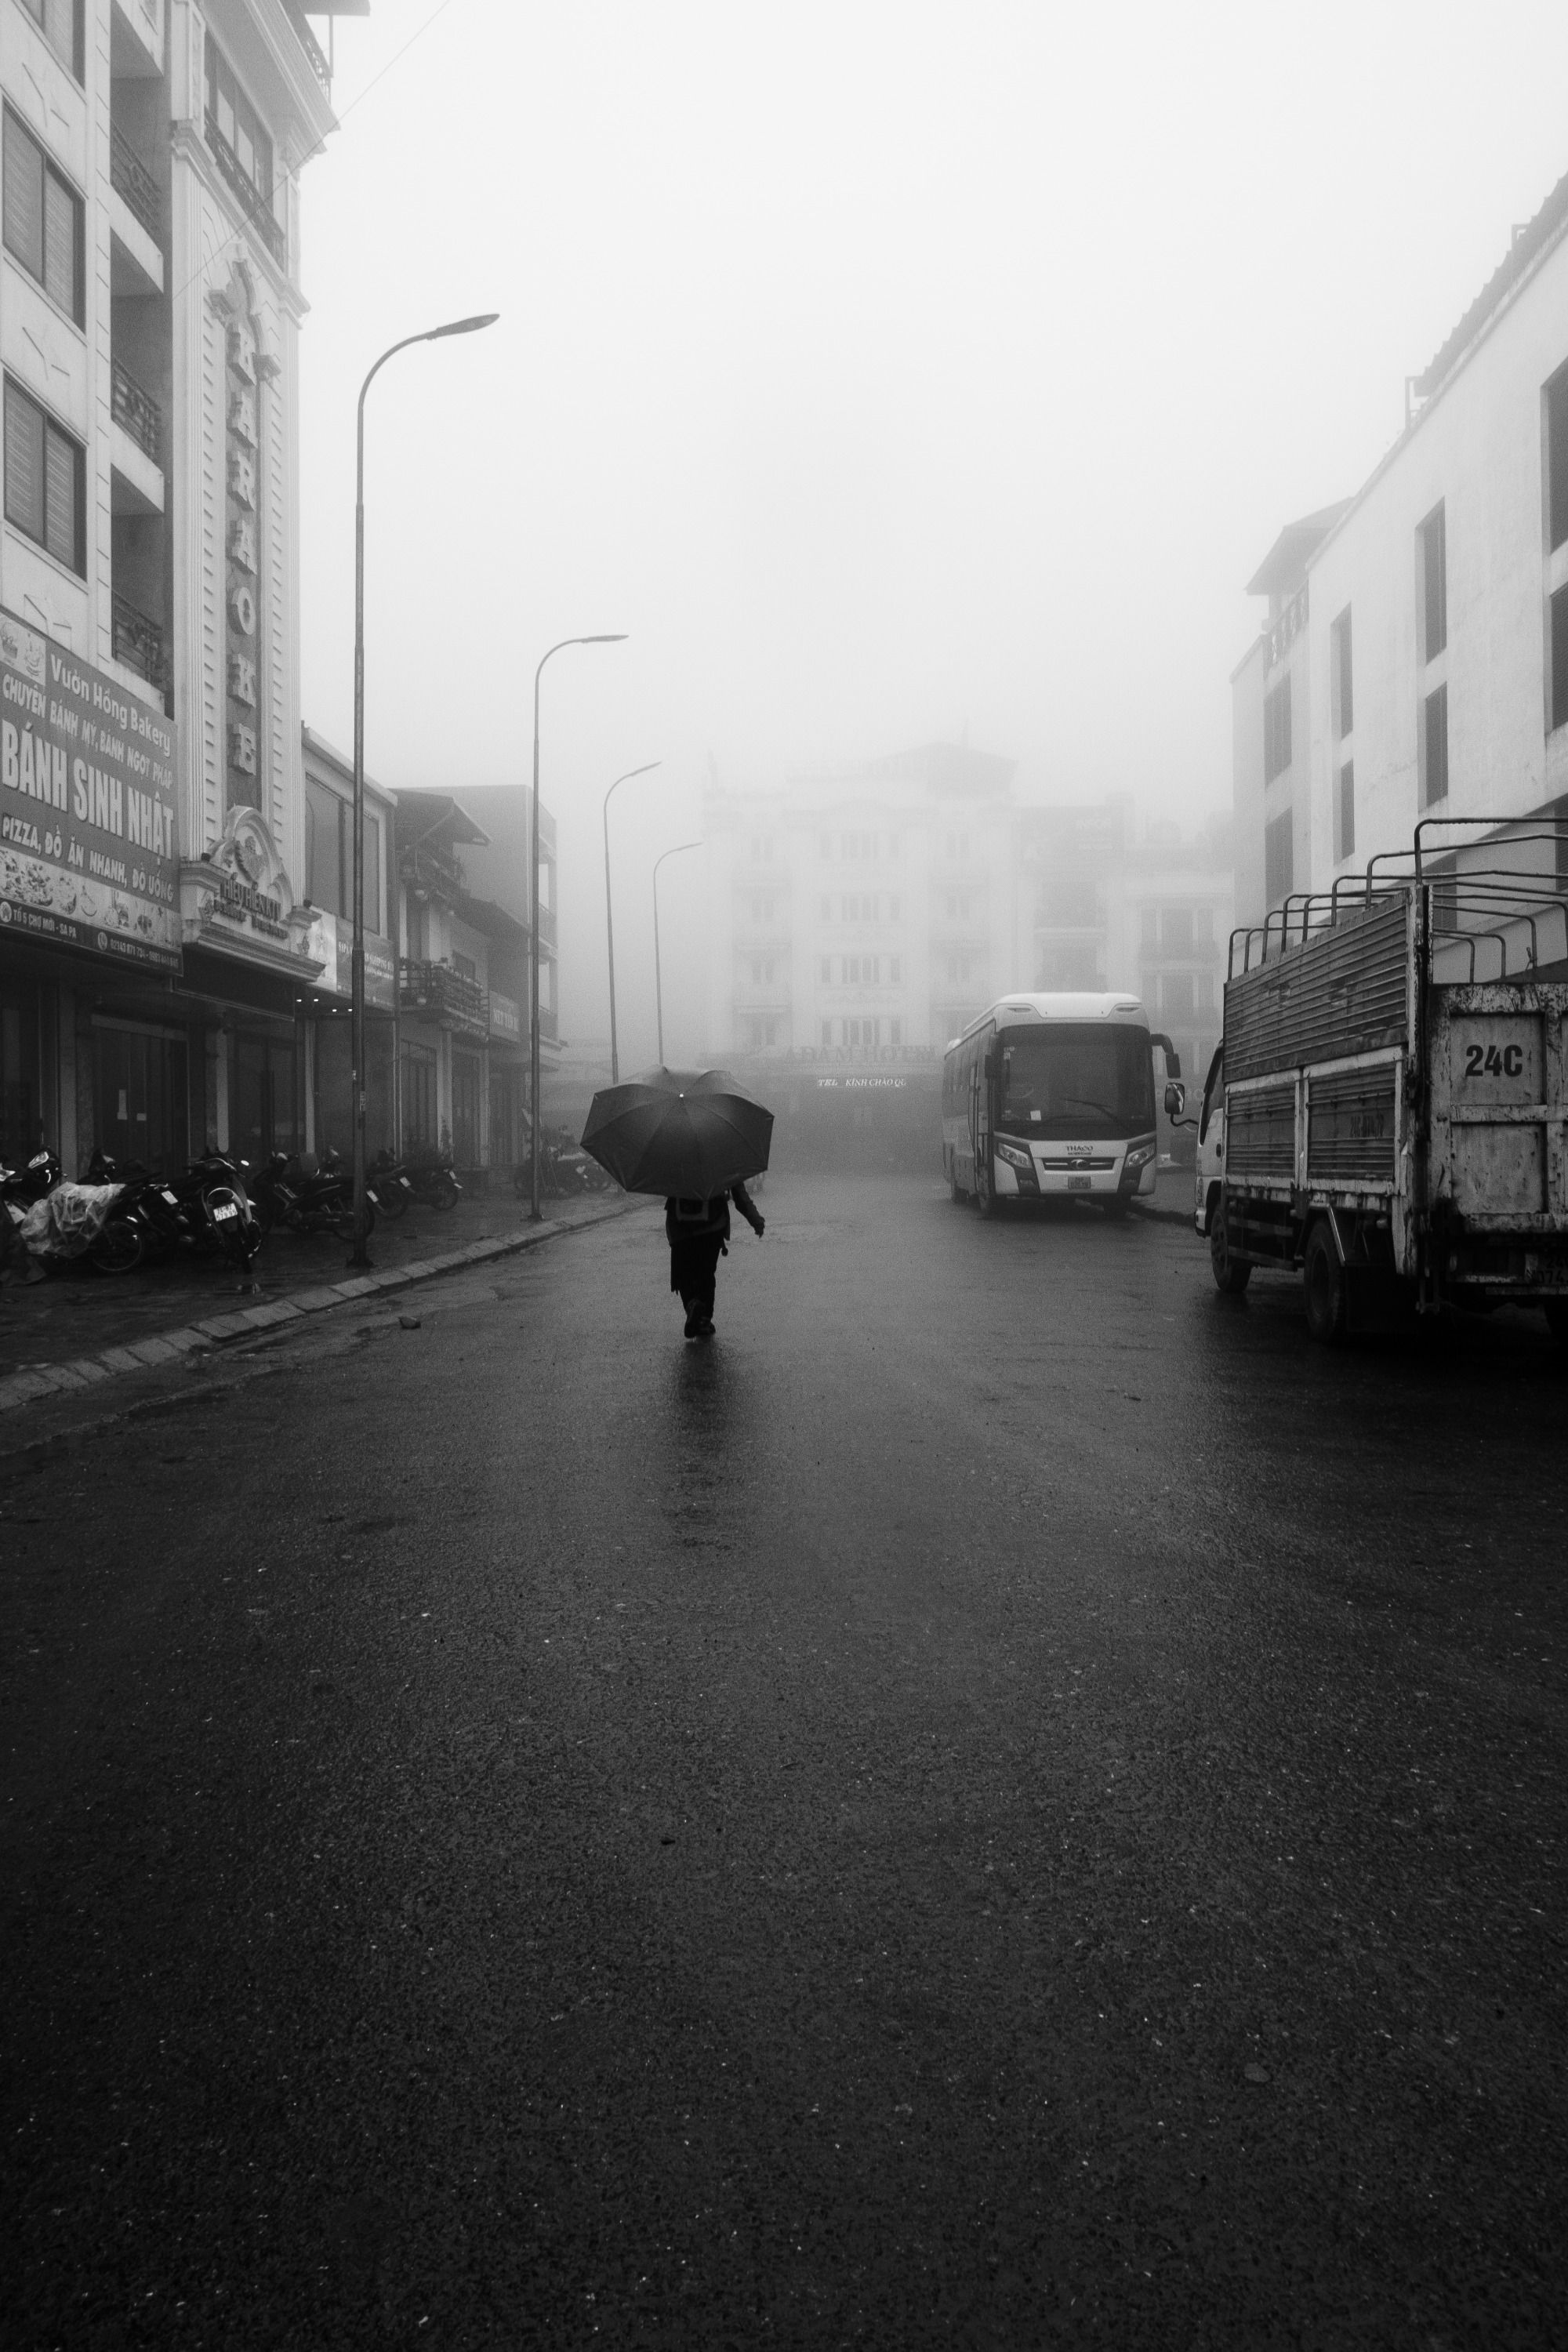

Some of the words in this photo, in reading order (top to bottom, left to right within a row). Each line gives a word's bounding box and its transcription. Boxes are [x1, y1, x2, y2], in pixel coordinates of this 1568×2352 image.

[229, 322, 258, 776] KARAOKE
[2, 673, 46, 718] CHUYÊN
[49, 699, 78, 737] BÁNH
[100, 729, 124, 763] BÁNH
[130, 707, 170, 757] Bakery
[2, 719, 67, 812] BÁNH
[73, 758, 122, 837] SINH
[128, 786, 173, 866] NHẬT
[2, 816, 42, 855] PIZZA,
[67, 836, 84, 868] ĂN
[89, 851, 127, 888] NHANH,
[148, 869, 174, 902] UỐNG
[1465, 1044, 1523, 1076] 24C
[1545, 1254, 1568, 1269] 24
